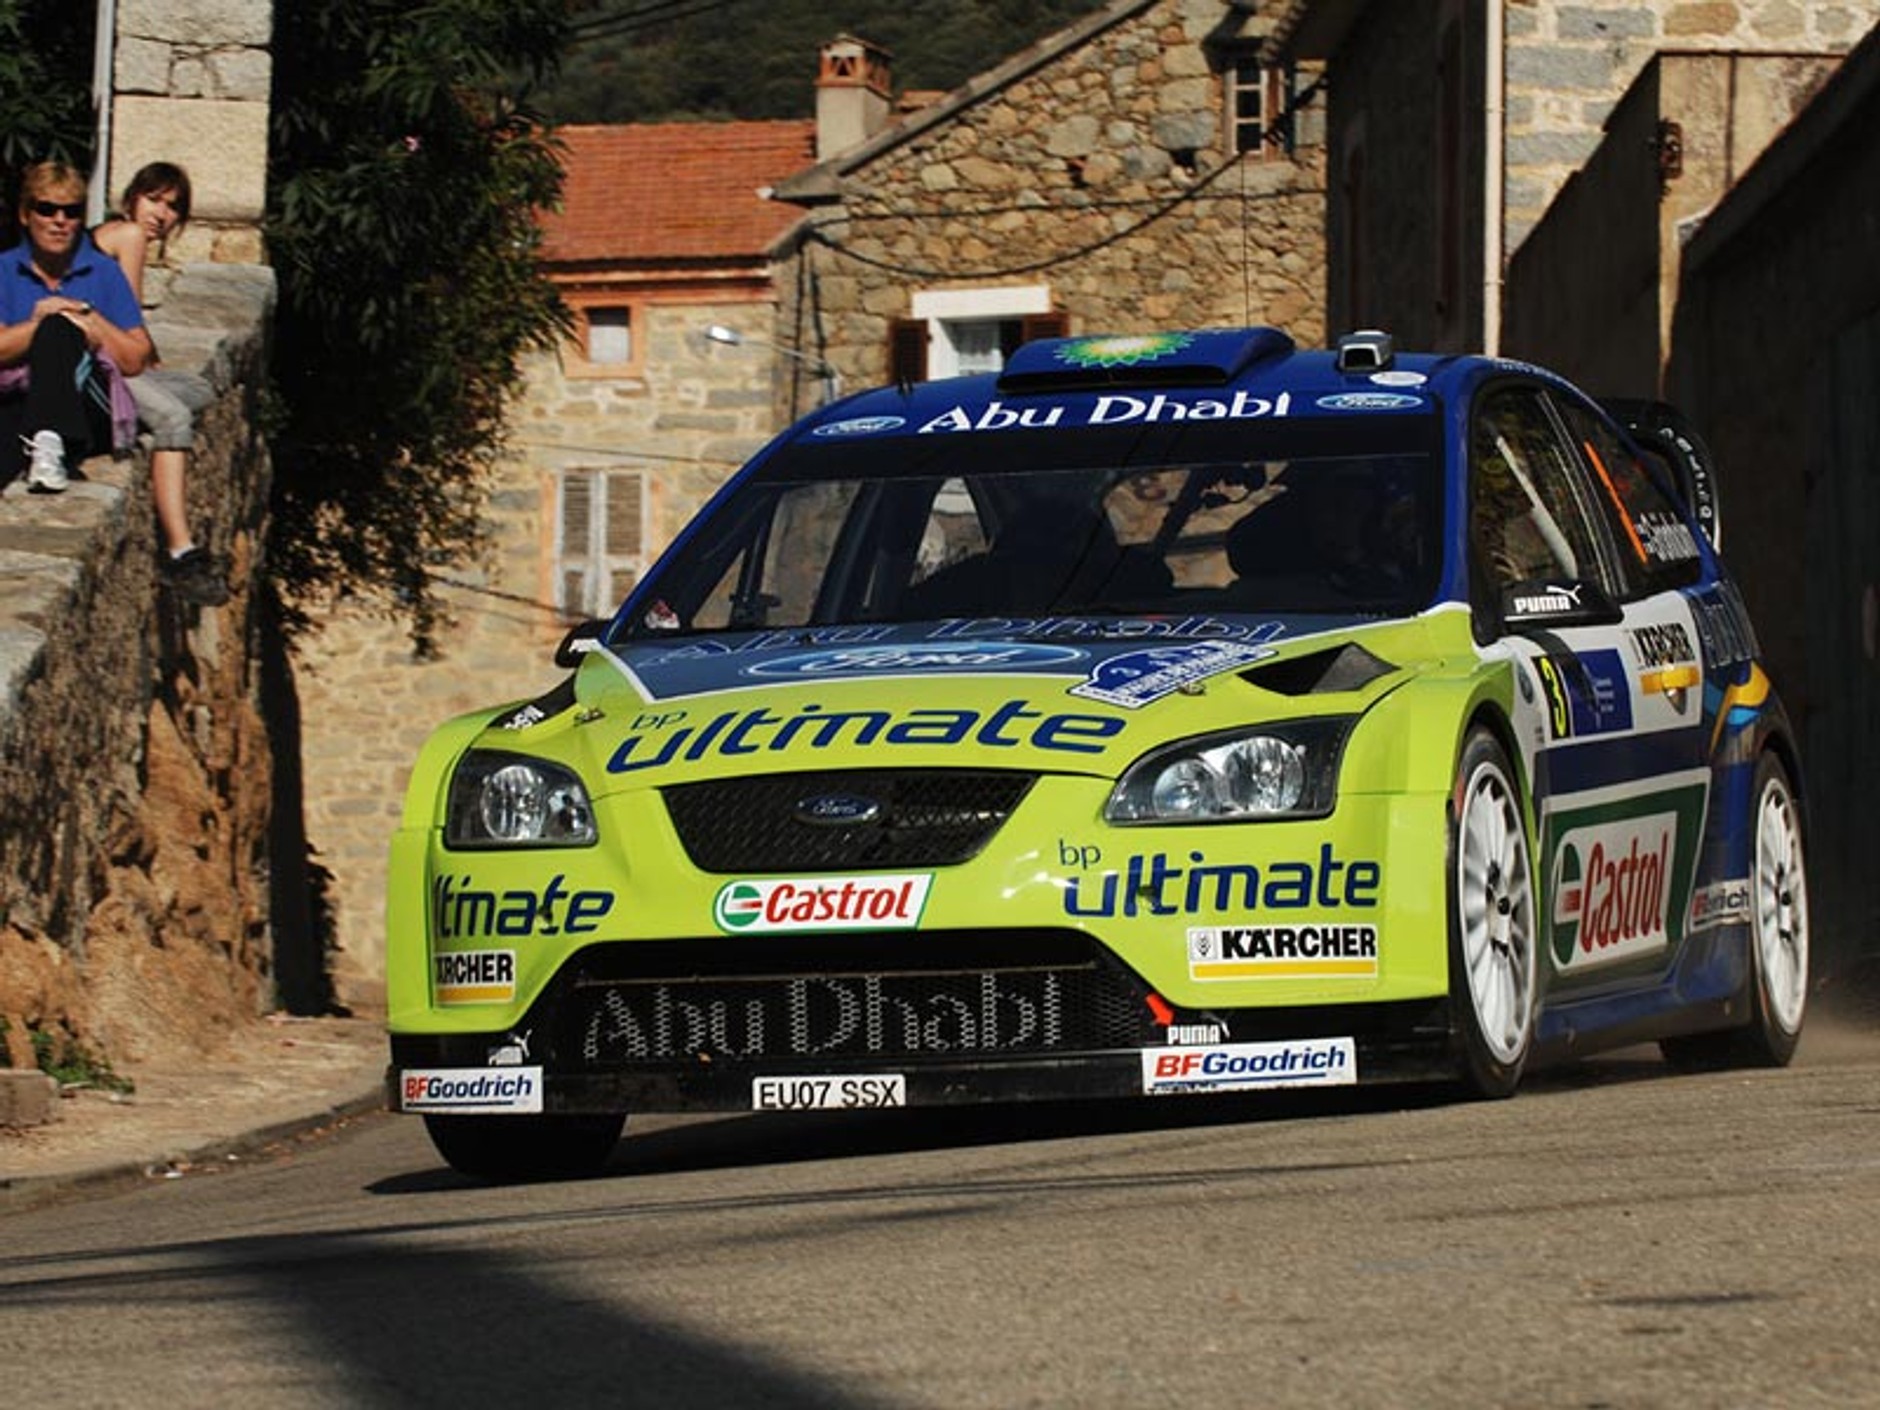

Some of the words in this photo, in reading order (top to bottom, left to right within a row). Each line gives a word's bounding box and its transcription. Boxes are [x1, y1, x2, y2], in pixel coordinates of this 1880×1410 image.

[918, 405, 1062, 433] Abu
[1087, 390, 1290, 425] Dhabi
[1513, 593, 1571, 614] PUMA
[1540, 656, 1567, 738] 3
[605, 700, 1127, 774] ultimate
[631, 711, 687, 730] bp
[1059, 838, 1101, 870] bp
[1062, 842, 1381, 918] ultimate
[1579, 830, 1668, 954] Castrol
[764, 880, 914, 925] Castrol
[1221, 926, 1376, 959] KÄRCHER
[583, 984, 765, 1059] Abu
[788, 972, 1062, 1053] Dhabi
[1167, 1025, 1221, 1045] PUMA
[1154, 1045, 1346, 1077] BFGoodrich
[404, 1073, 533, 1100] BFGoodrich
[759, 1080, 832, 1110] EU07
[840, 1079, 899, 1108] SSX
